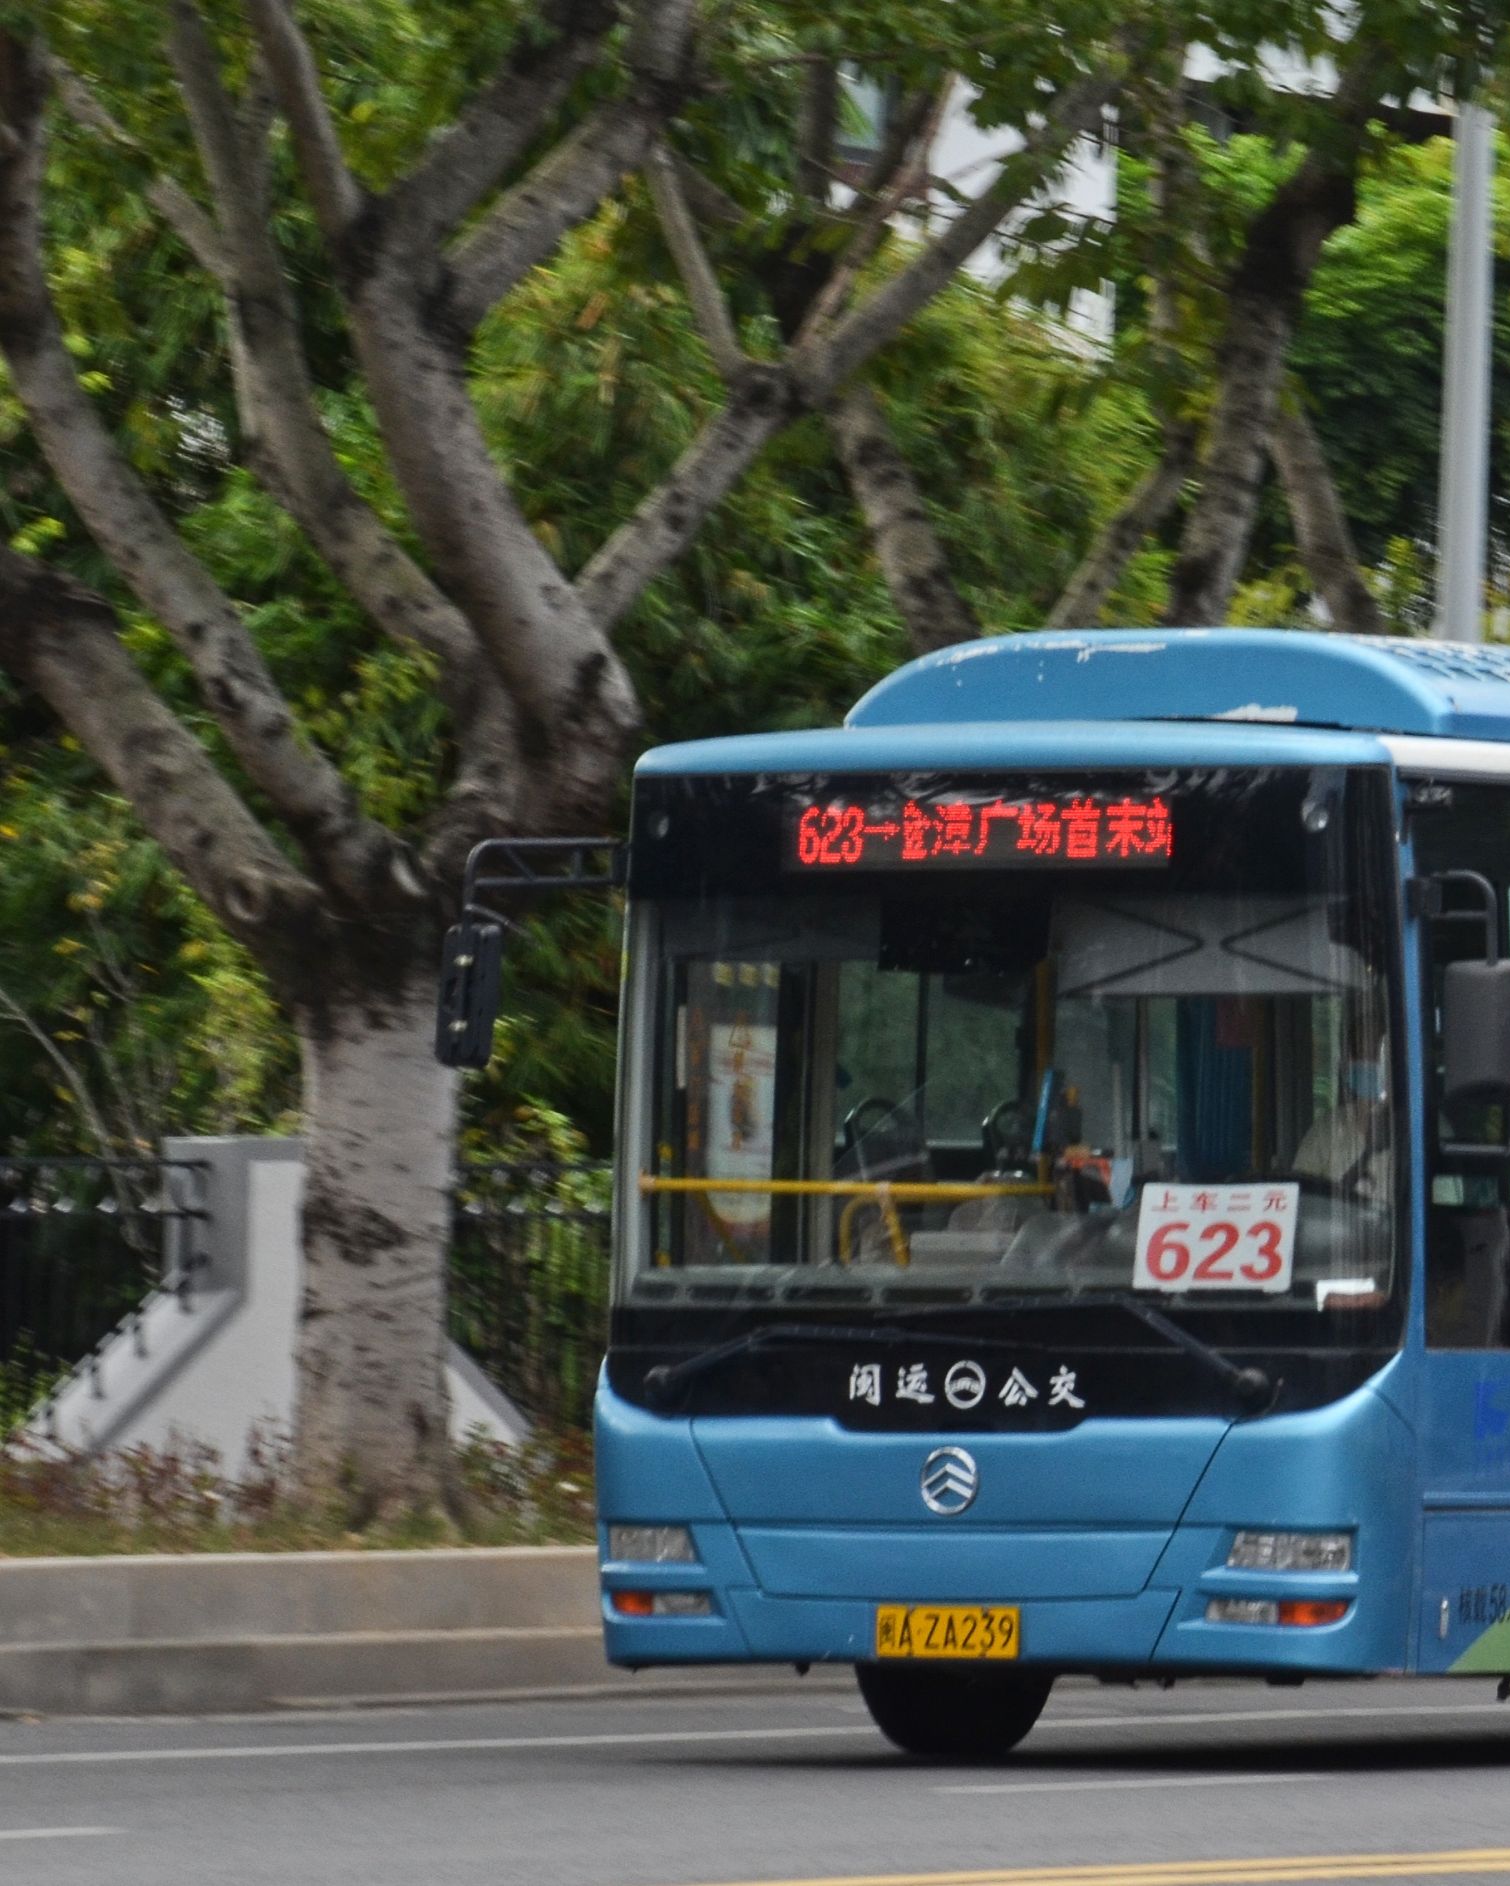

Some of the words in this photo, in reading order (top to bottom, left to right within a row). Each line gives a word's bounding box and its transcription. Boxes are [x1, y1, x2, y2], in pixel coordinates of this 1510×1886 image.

[799, 806, 864, 864] 623
[1151, 1190, 1287, 1214] 上车二元
[1146, 1221, 1282, 1282] 623
